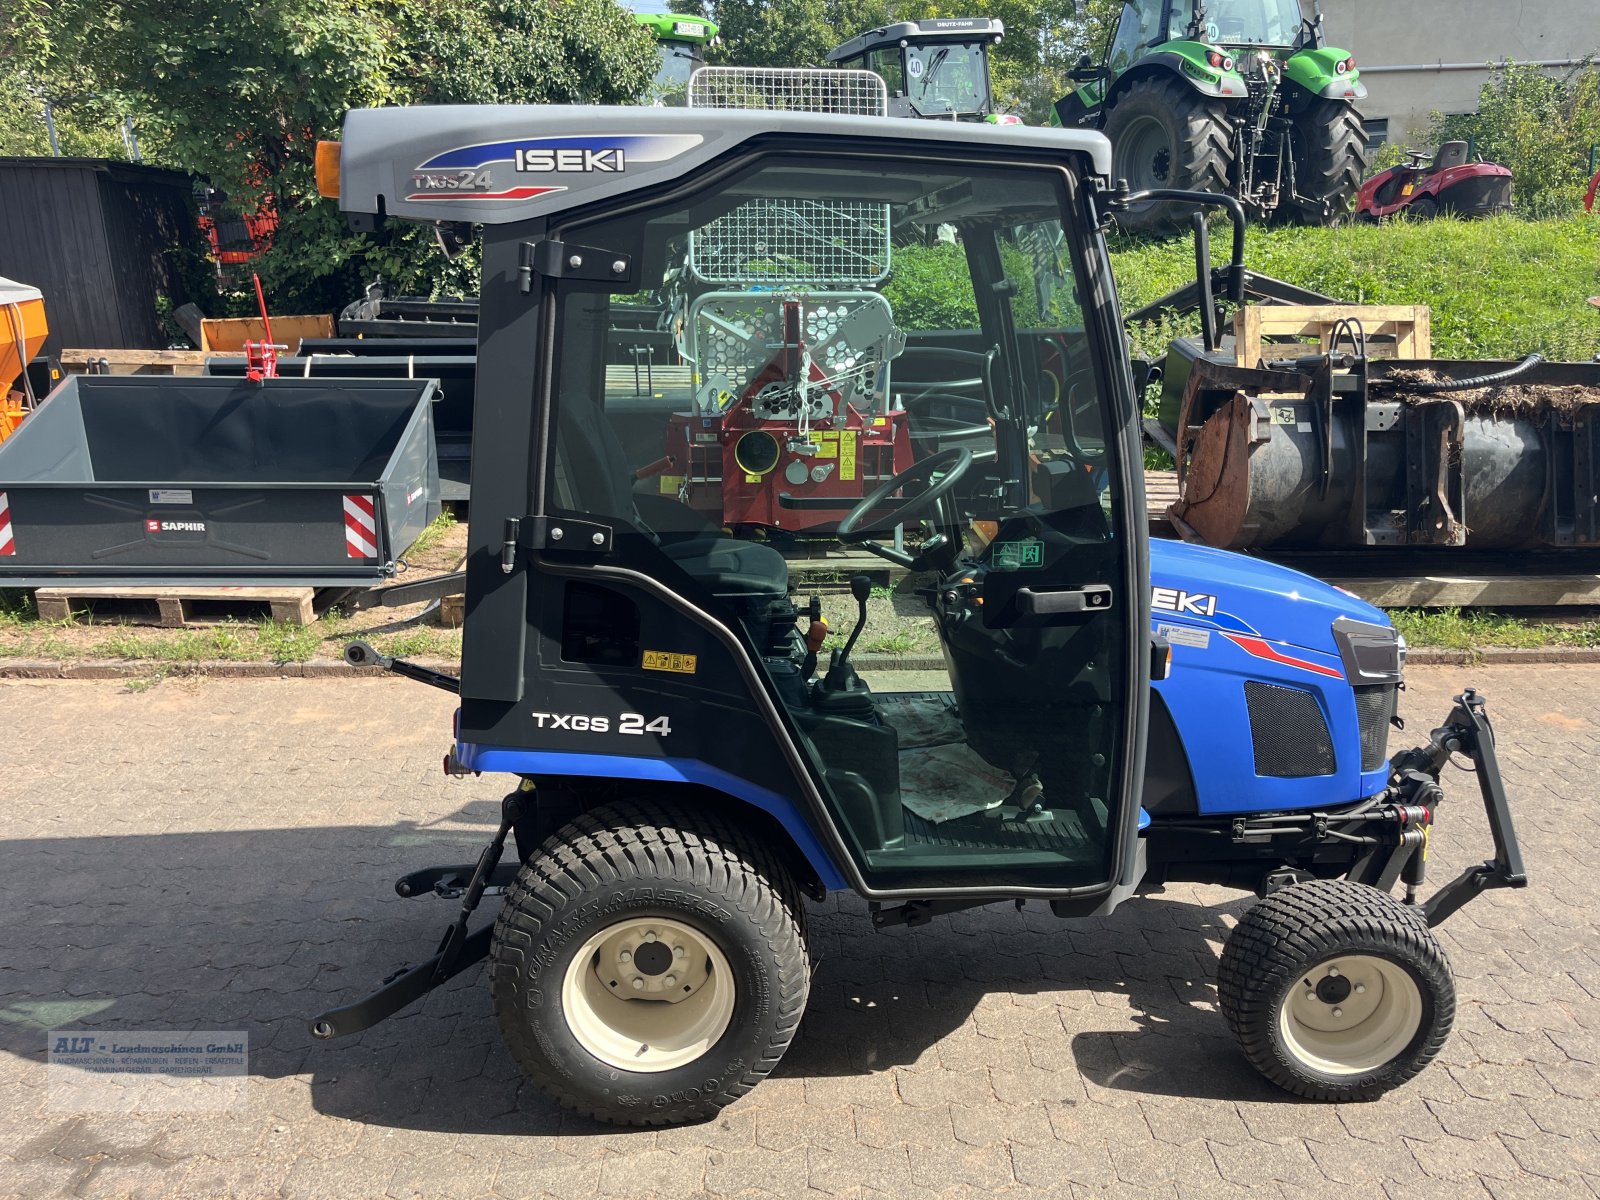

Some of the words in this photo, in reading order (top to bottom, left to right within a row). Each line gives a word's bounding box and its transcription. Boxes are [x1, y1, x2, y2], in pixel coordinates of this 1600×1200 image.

[910, 61, 921, 74] 40
[515, 149, 625, 172] ISEKI
[161, 522, 206, 532] SAPHIR
[1151, 586, 1217, 617] EKI
[532, 712, 609, 733] TXGS
[618, 712, 672, 737] 24
[610, 887, 734, 924] MASTER
